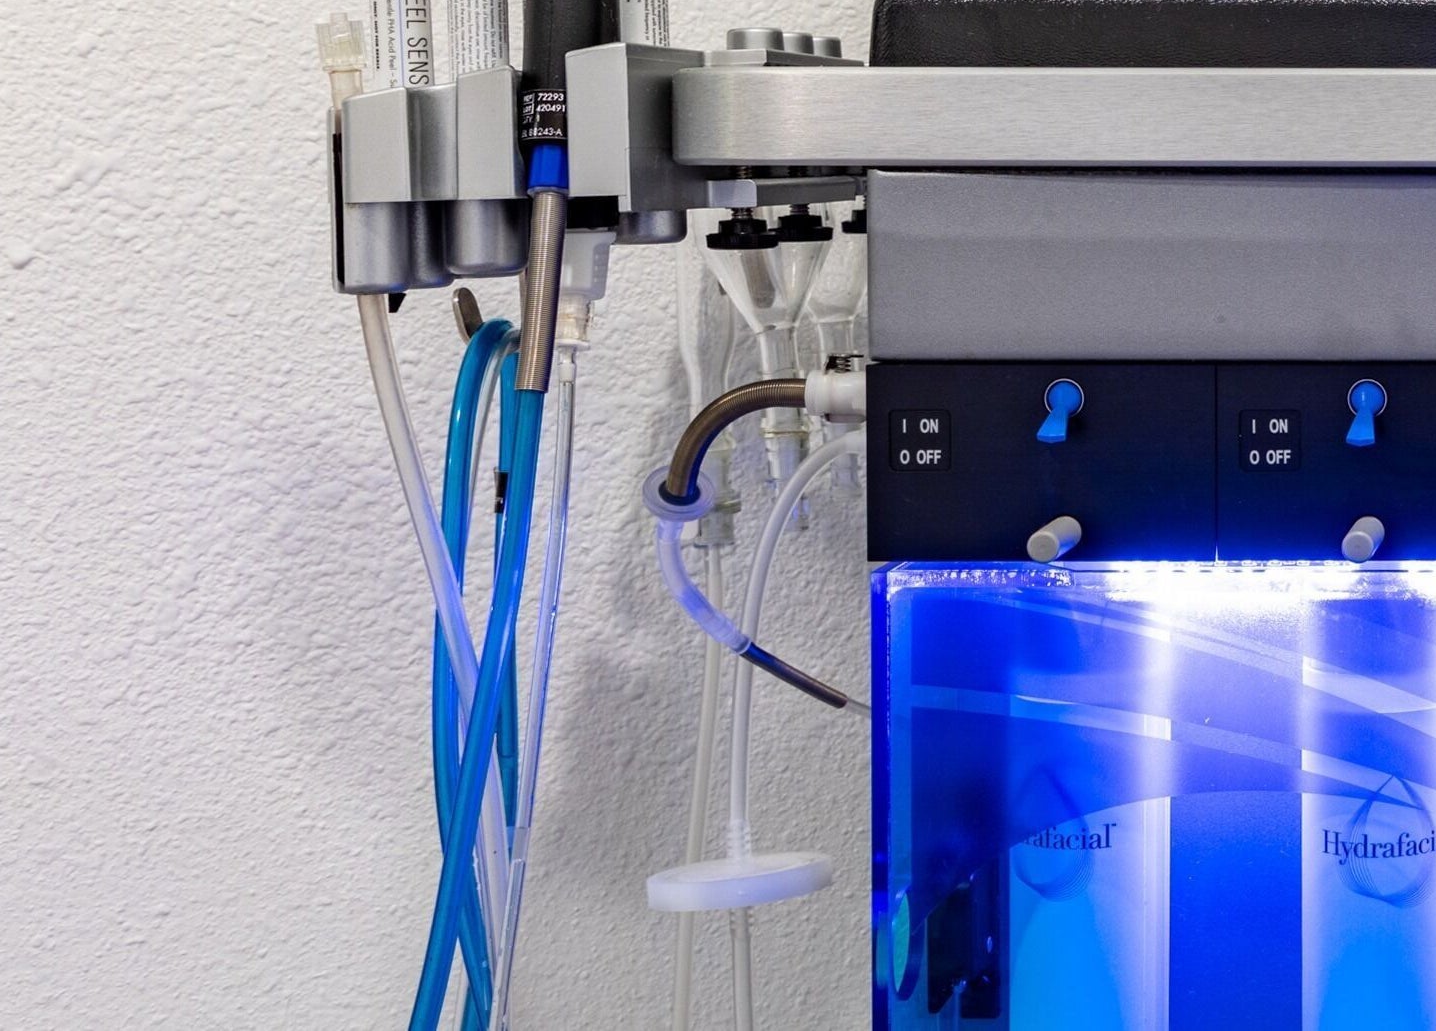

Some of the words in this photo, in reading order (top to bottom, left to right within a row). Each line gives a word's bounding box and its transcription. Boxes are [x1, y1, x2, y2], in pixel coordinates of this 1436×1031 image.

[406, 36, 430, 85] SENS
[537, 93, 564, 101] 72293
[535, 103, 566, 113] 420491
[920, 419, 938, 433] ON
[1269, 419, 1288, 433] ON
[916, 450, 942, 464] OFF
[1266, 450, 1291, 464] OFF
